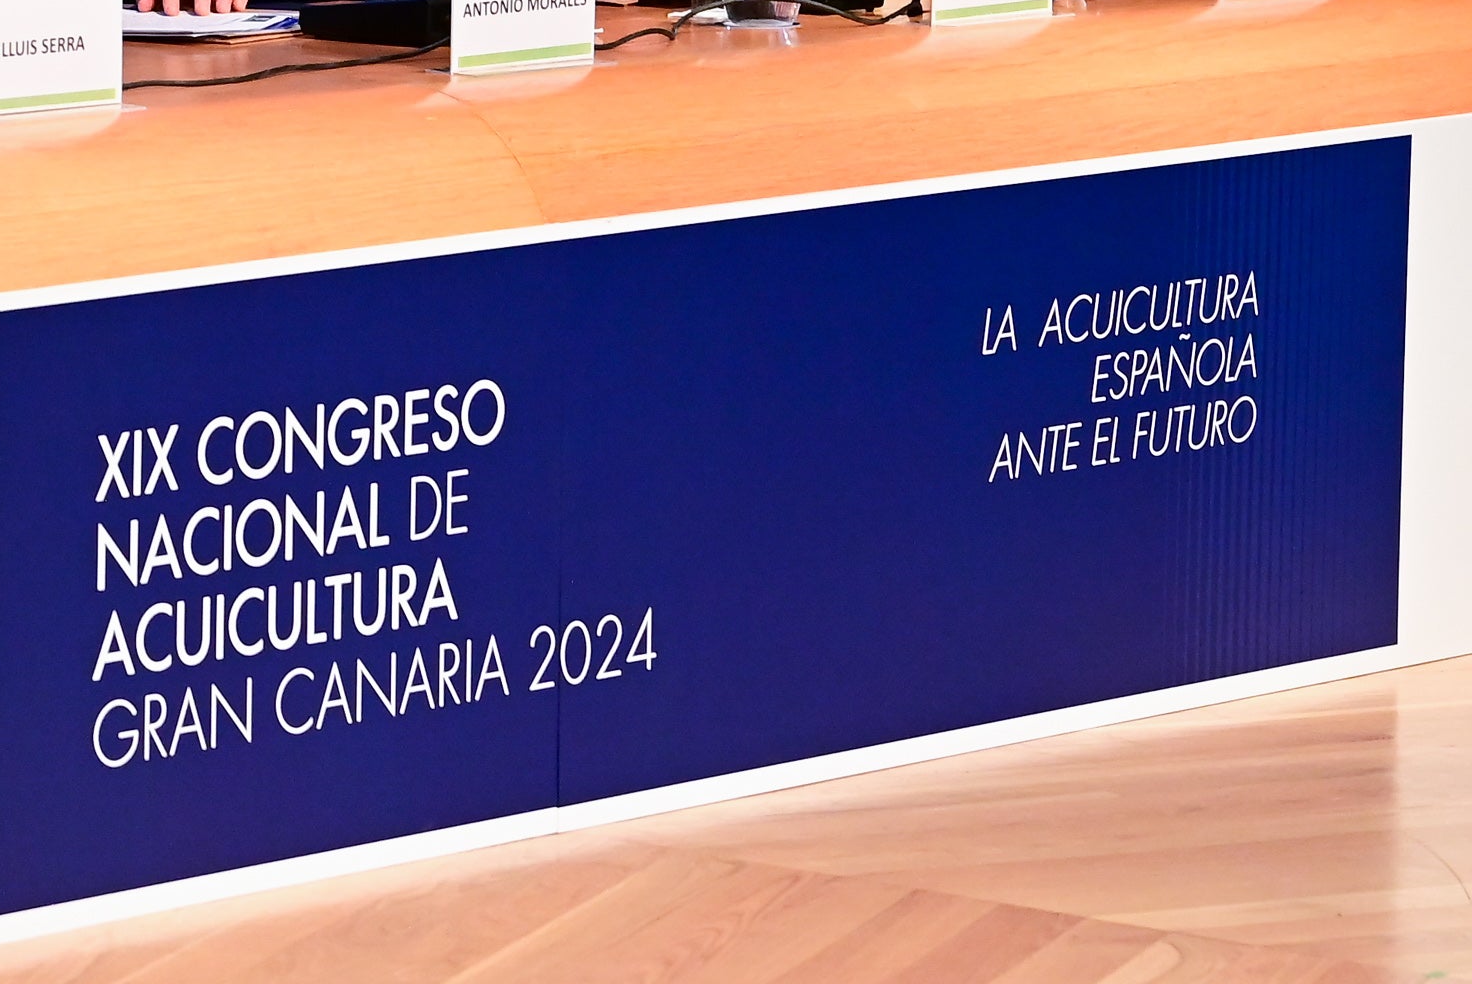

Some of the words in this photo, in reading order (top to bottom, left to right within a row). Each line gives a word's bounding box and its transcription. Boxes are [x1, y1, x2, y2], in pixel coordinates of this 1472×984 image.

[2, 39, 37, 57] LLUIS
[41, 36, 85, 54] SERRA
[982, 304, 1017, 356] LA
[1038, 270, 1259, 348] ACUICULTURA
[1091, 332, 1257, 403] ESPAÑOLA
[95, 424, 179, 503] XIX
[197, 379, 506, 485] CONGRESO
[988, 422, 1082, 483] ANTE
[1091, 416, 1121, 466] EL
[1132, 395, 1257, 460] FUTURO
[96, 482, 390, 592] NACIONAL
[409, 469, 470, 542] DE
[91, 557, 459, 682] ACUICULTURA
[92, 677, 254, 769] GRAN
[275, 634, 510, 735] CANARIA
[528, 606, 658, 692] 2024
